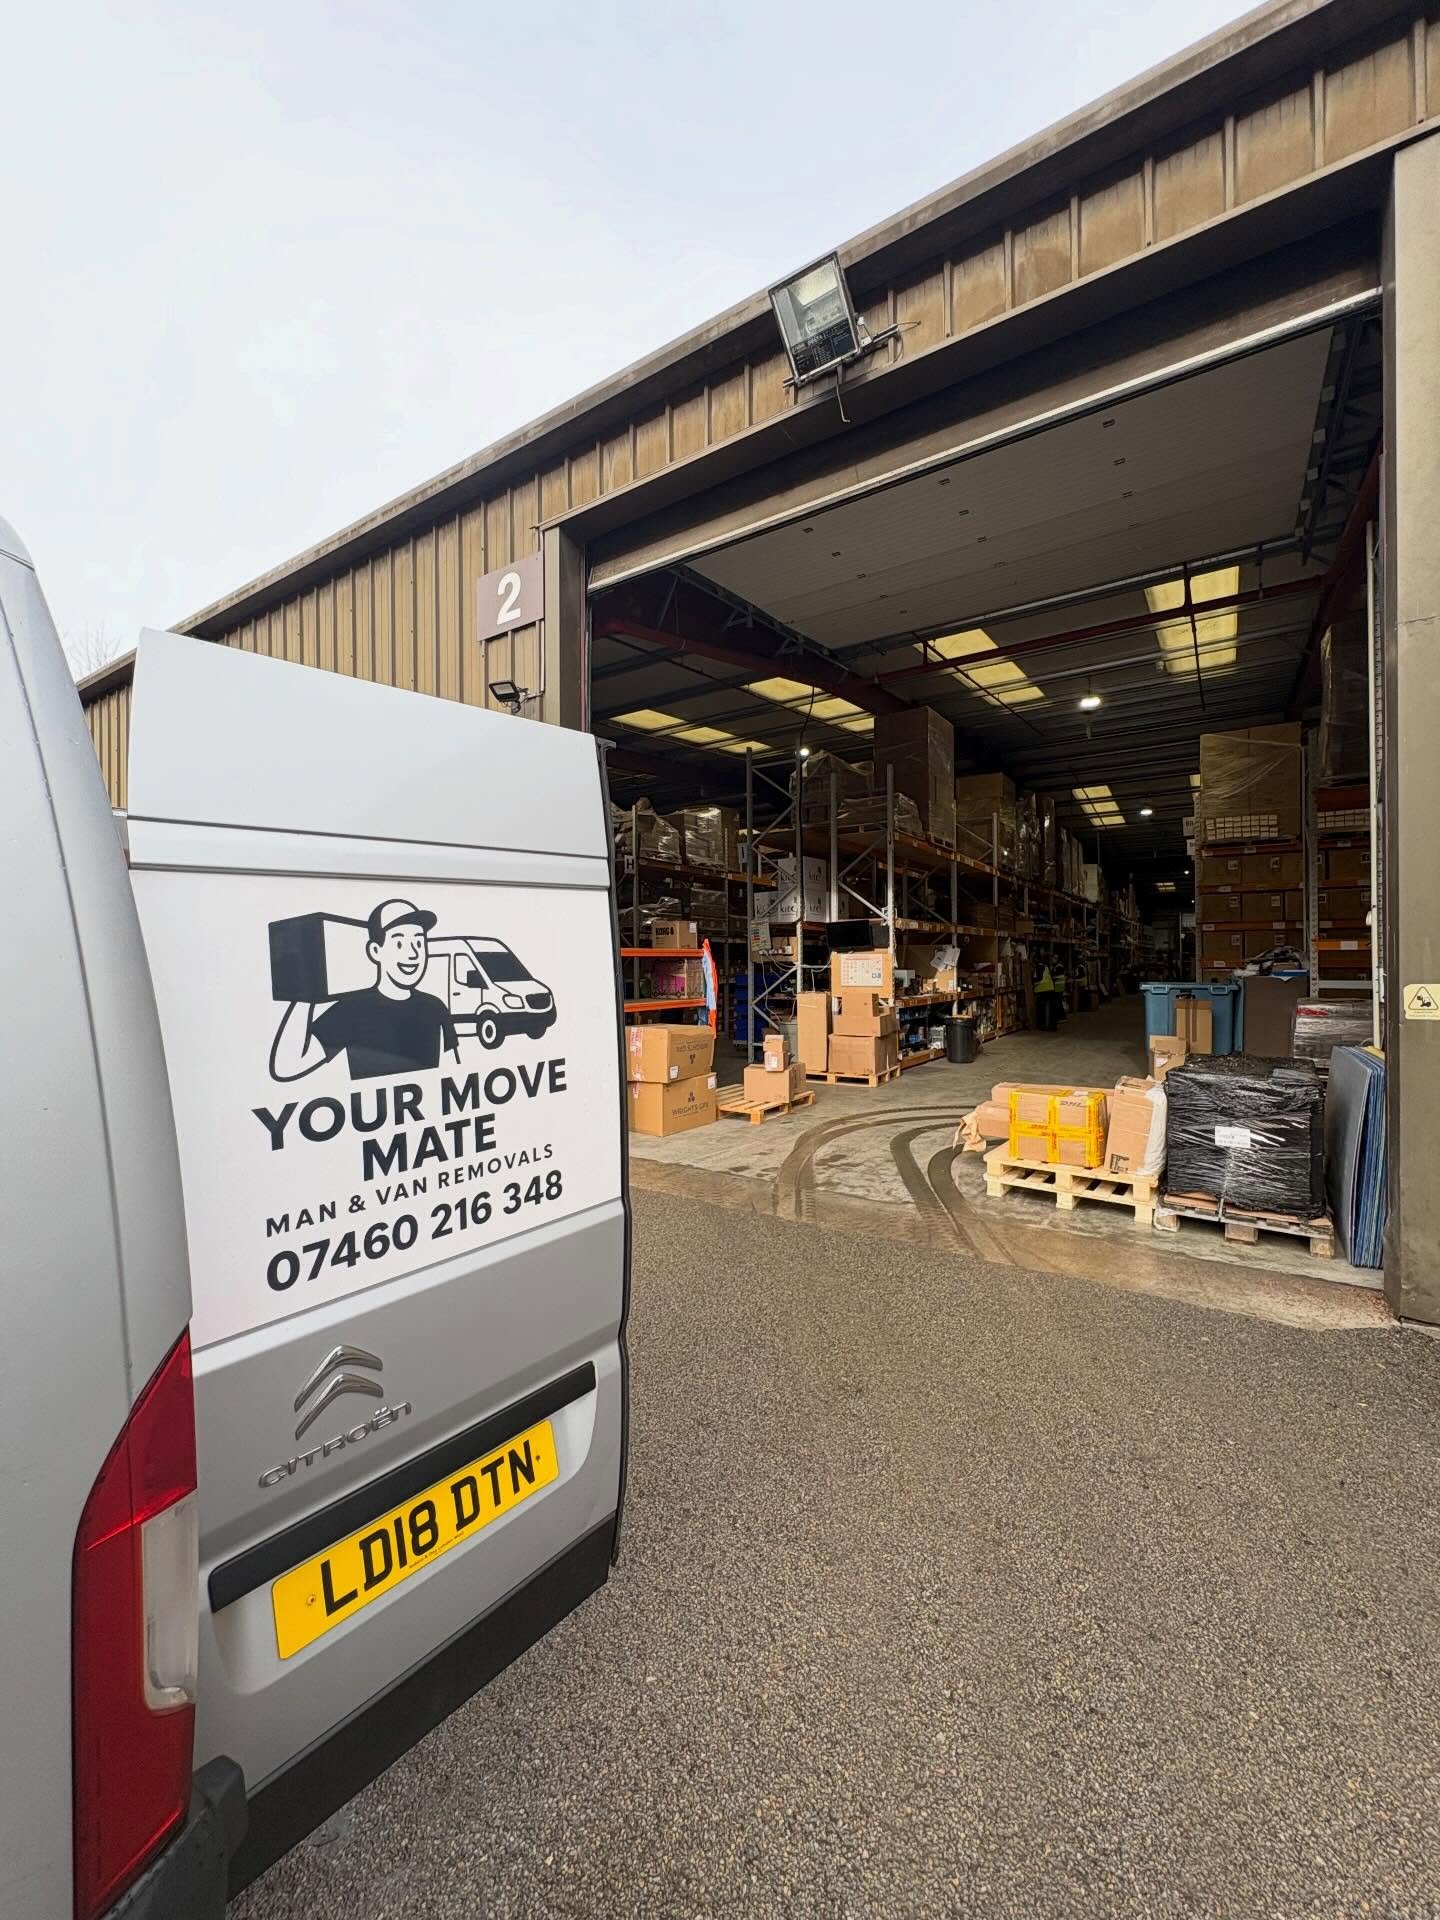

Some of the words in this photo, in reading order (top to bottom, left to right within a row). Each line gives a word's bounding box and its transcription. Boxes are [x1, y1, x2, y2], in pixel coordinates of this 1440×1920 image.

[497, 572, 521, 625] 2
[626, 857, 634, 869] H
[251, 1082, 425, 1152] YOUR
[441, 1057, 568, 1115] MOVE
[362, 1112, 497, 1182] MATE
[265, 1200, 337, 1238] MAN
[348, 1194, 366, 1213] &
[375, 1176, 428, 1205] VAN
[438, 1143, 554, 1189] REMOVALS
[265, 1213, 419, 1292] 07460
[431, 1191, 493, 1240] 216
[502, 1169, 564, 1215] 348
[320, 1499, 439, 1617] LD18
[450, 1440, 536, 1532] DTN
